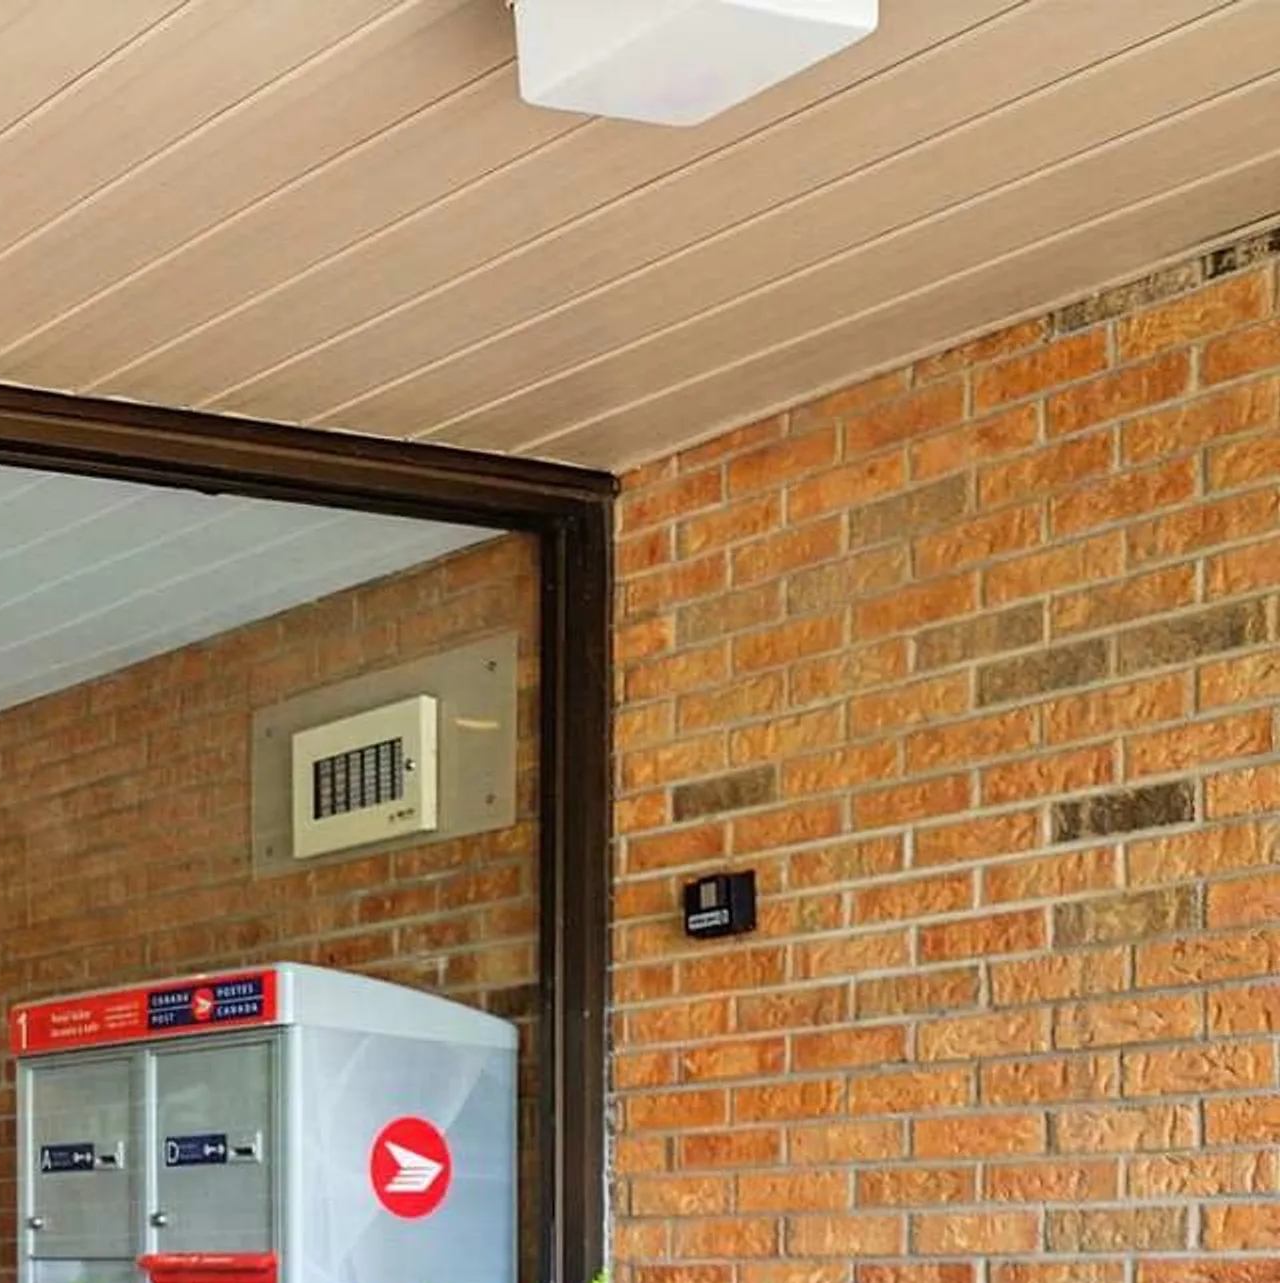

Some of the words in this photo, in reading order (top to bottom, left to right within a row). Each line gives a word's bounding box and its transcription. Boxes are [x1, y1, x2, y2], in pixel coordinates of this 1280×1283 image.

[216, 1002, 258, 1017] CANADA
[151, 1012, 175, 1025] POST
[42, 1149, 52, 1169] A
[167, 1141, 180, 1163] D
